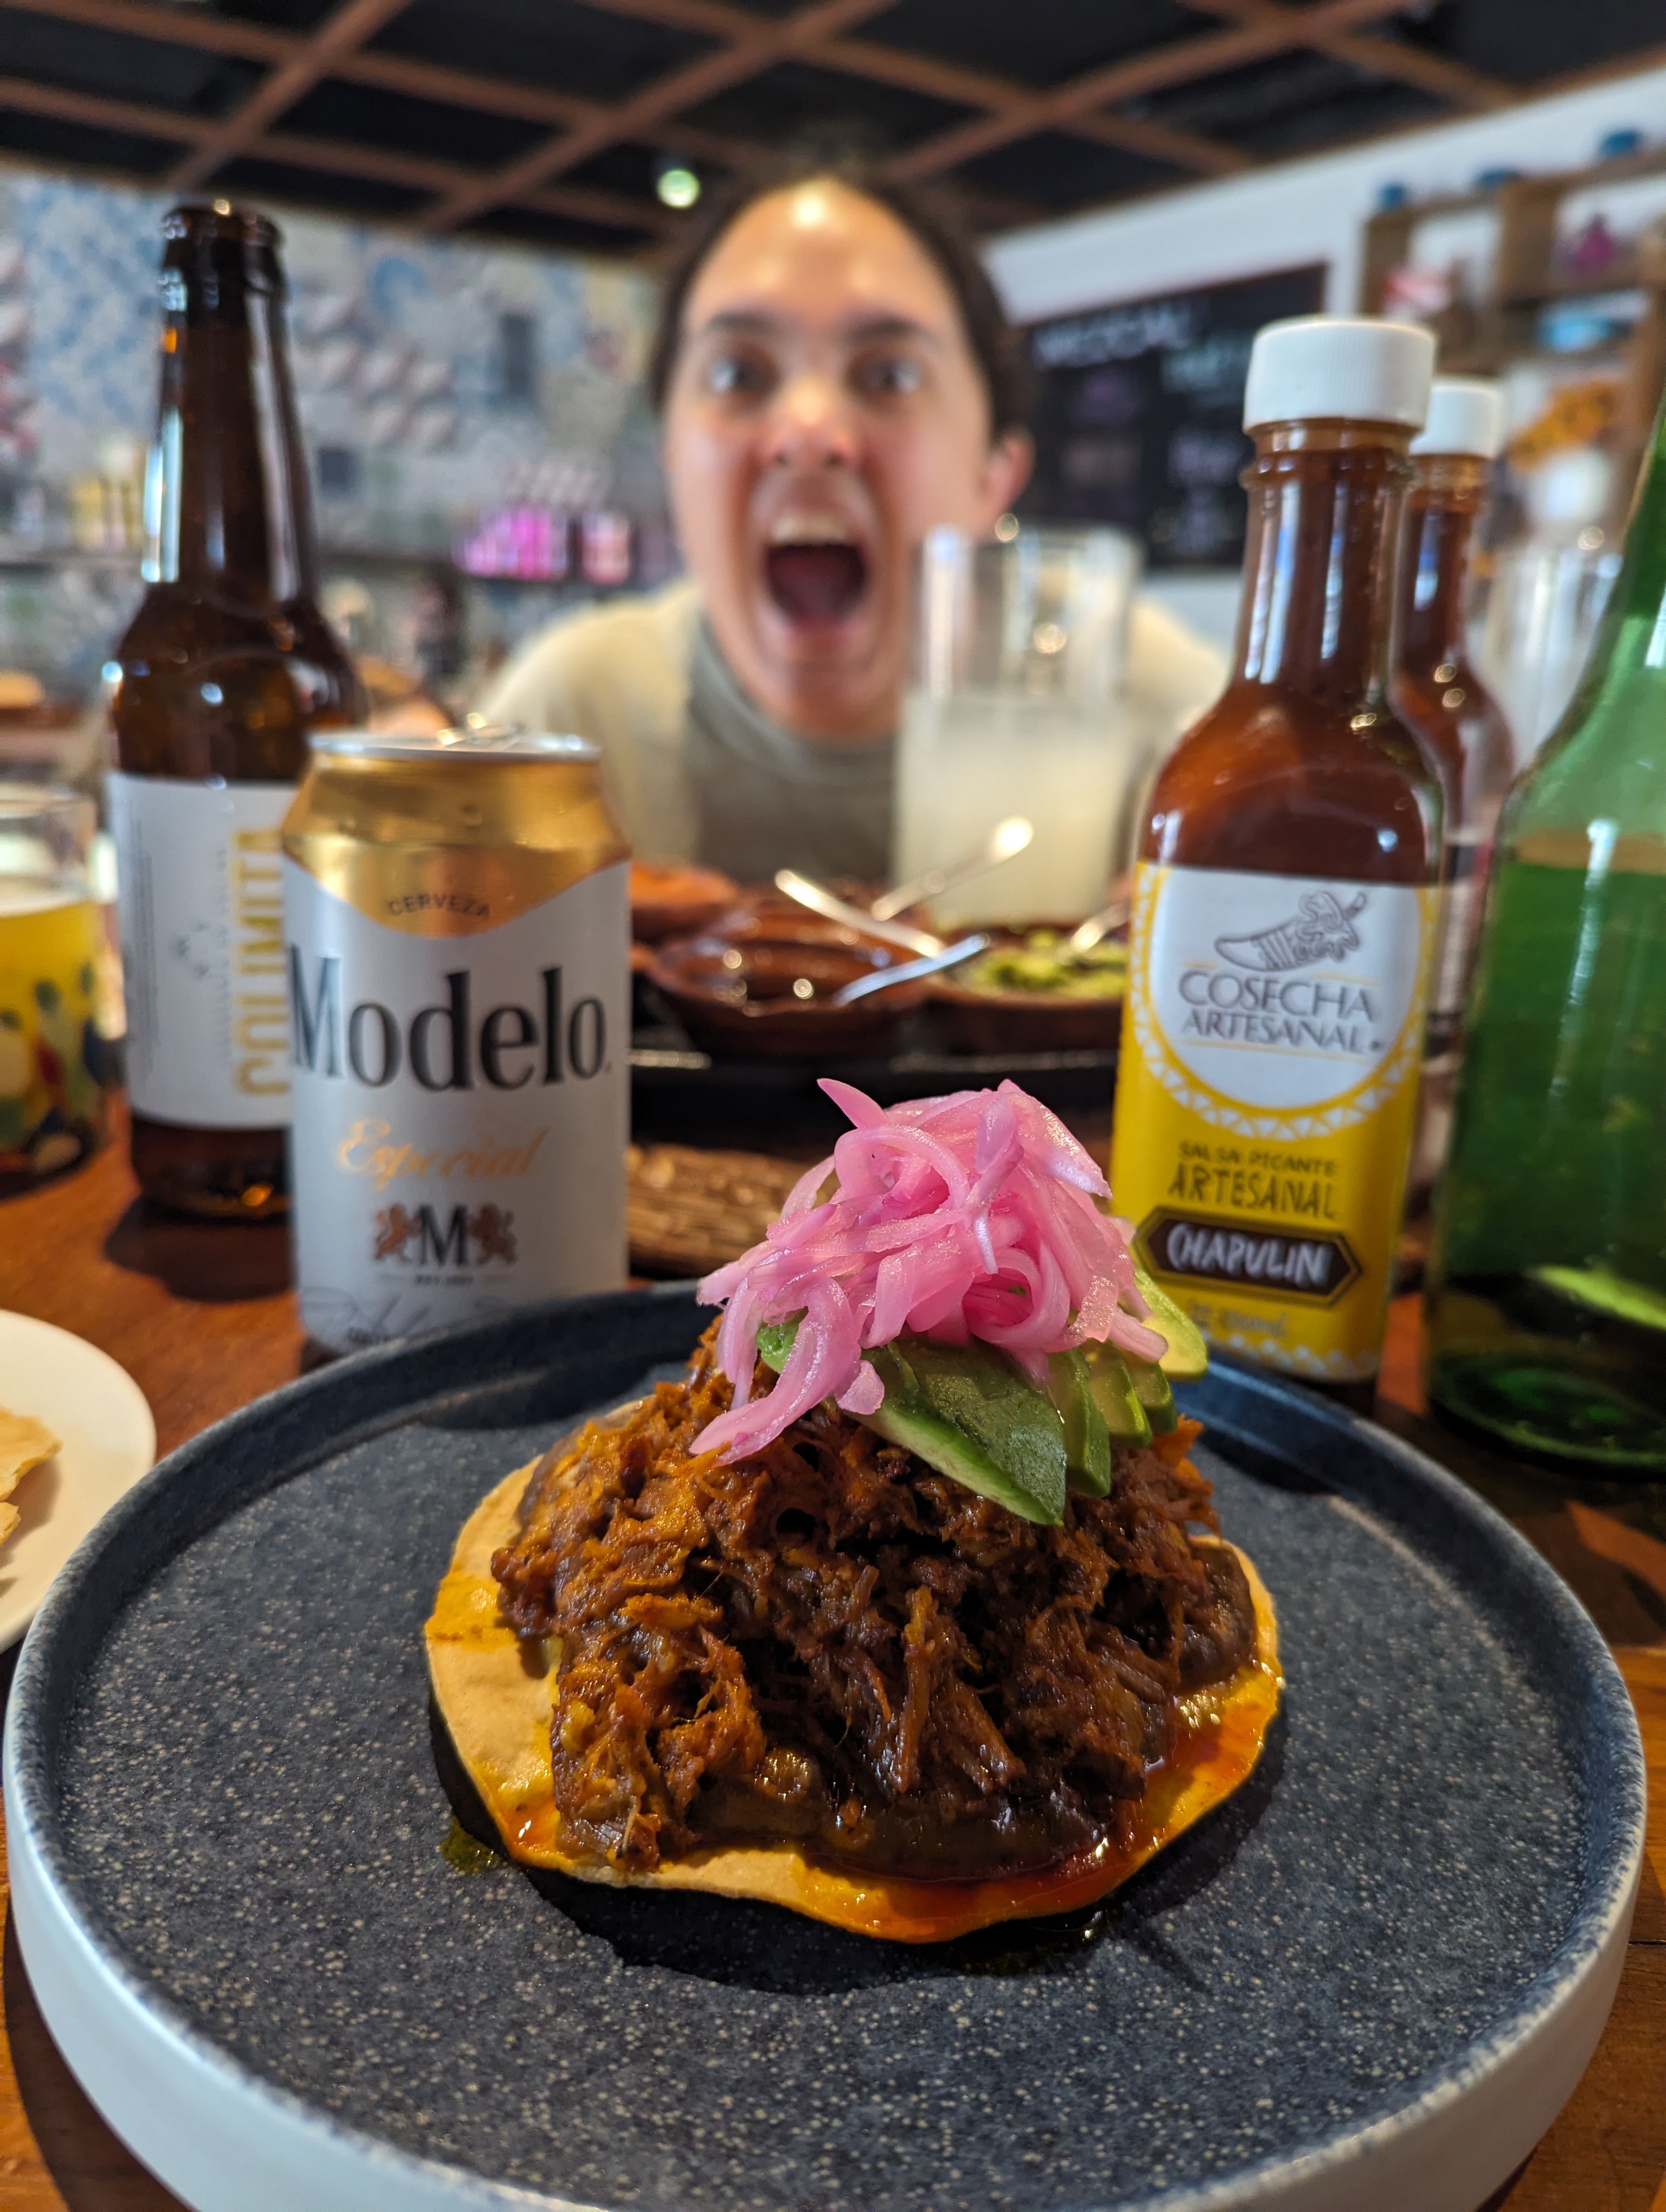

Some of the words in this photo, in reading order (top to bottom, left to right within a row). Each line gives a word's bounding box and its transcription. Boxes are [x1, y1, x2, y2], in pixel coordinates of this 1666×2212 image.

[387, 893, 490, 916] CERVEZA
[289, 942, 606, 1091] Modelo
[1179, 969, 1375, 1023] COSECHA
[1182, 1008, 1364, 1054] ARTESANAL
[336, 1117, 549, 1191] Especial
[1179, 1140, 1240, 1163] SALSA
[1248, 1150, 1338, 1176] PICANTE
[1168, 1163, 1336, 1219] ARTESANAL
[418, 1204, 468, 1266] M
[1167, 1223, 1334, 1288] CHAPULIN
